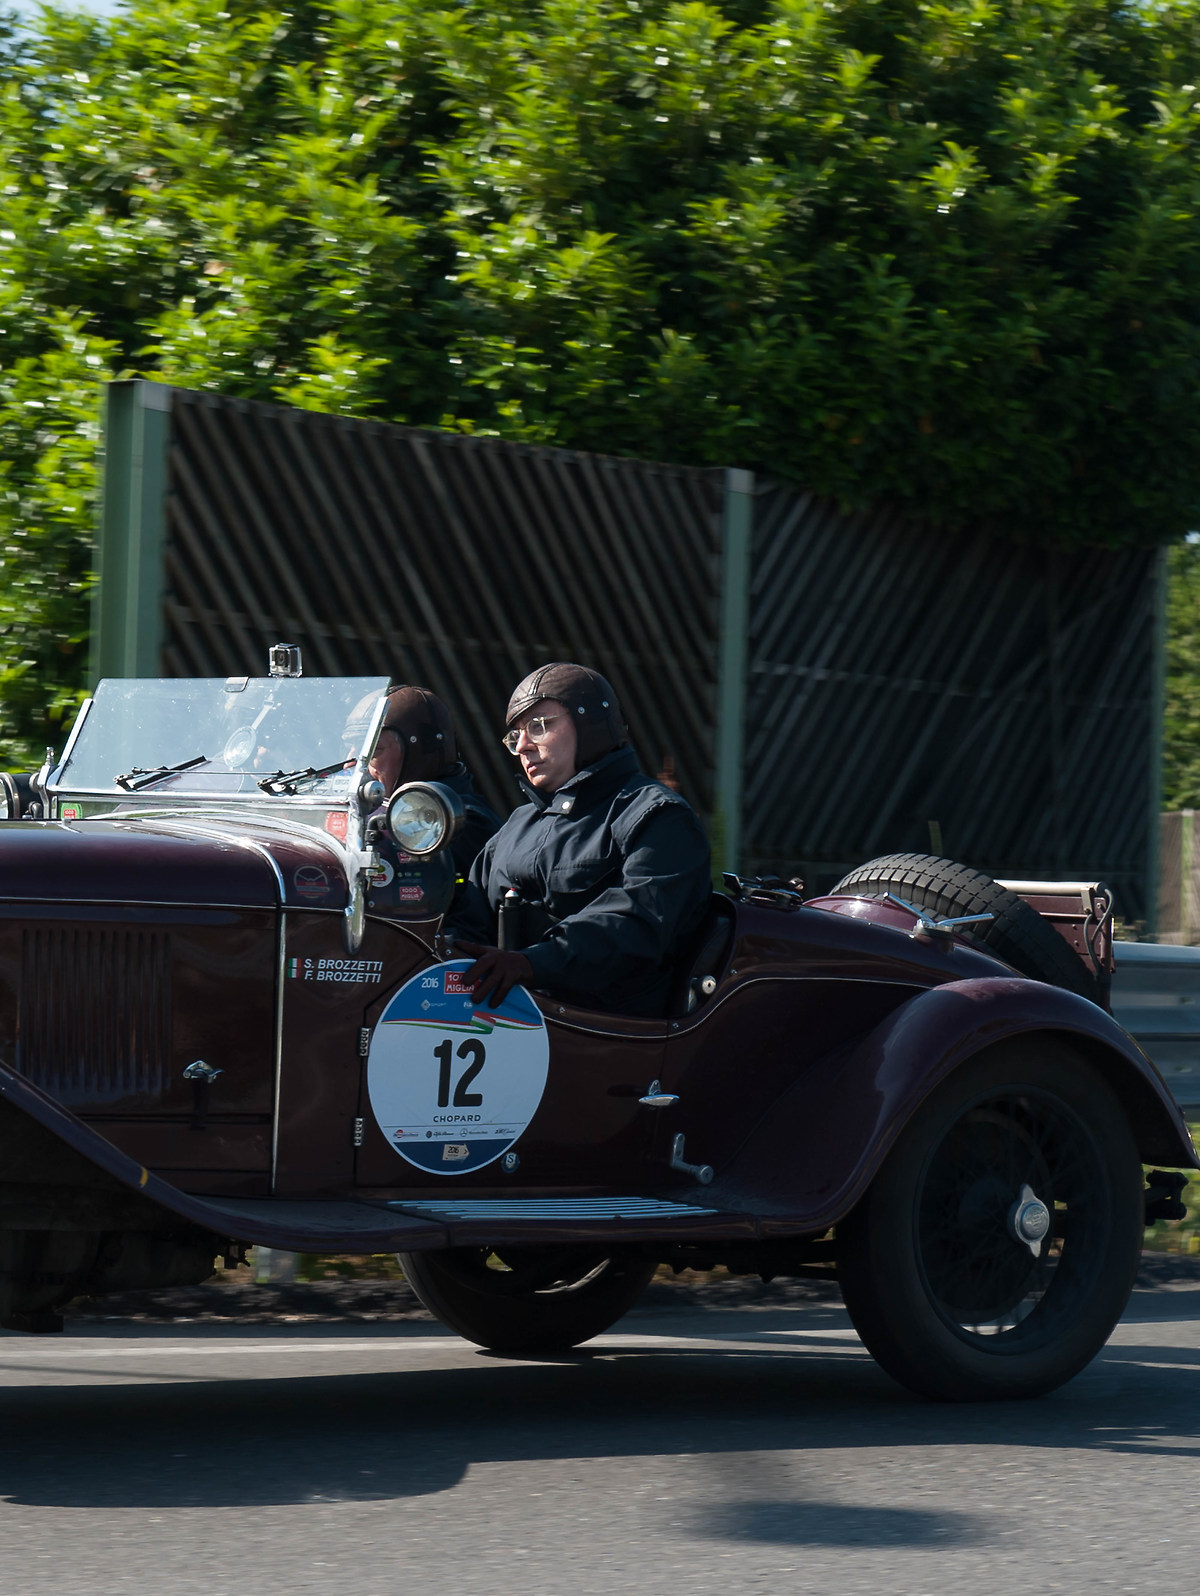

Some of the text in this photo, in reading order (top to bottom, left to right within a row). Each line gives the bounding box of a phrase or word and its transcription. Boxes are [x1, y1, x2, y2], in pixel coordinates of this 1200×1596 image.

[304, 958, 383, 972] S. BROZZETTI
[304, 970, 382, 983] F. BROZZETTI
[421, 977, 439, 988] 2016
[433, 1038, 486, 1108] 12
[433, 1114, 481, 1123] CHOPARD
